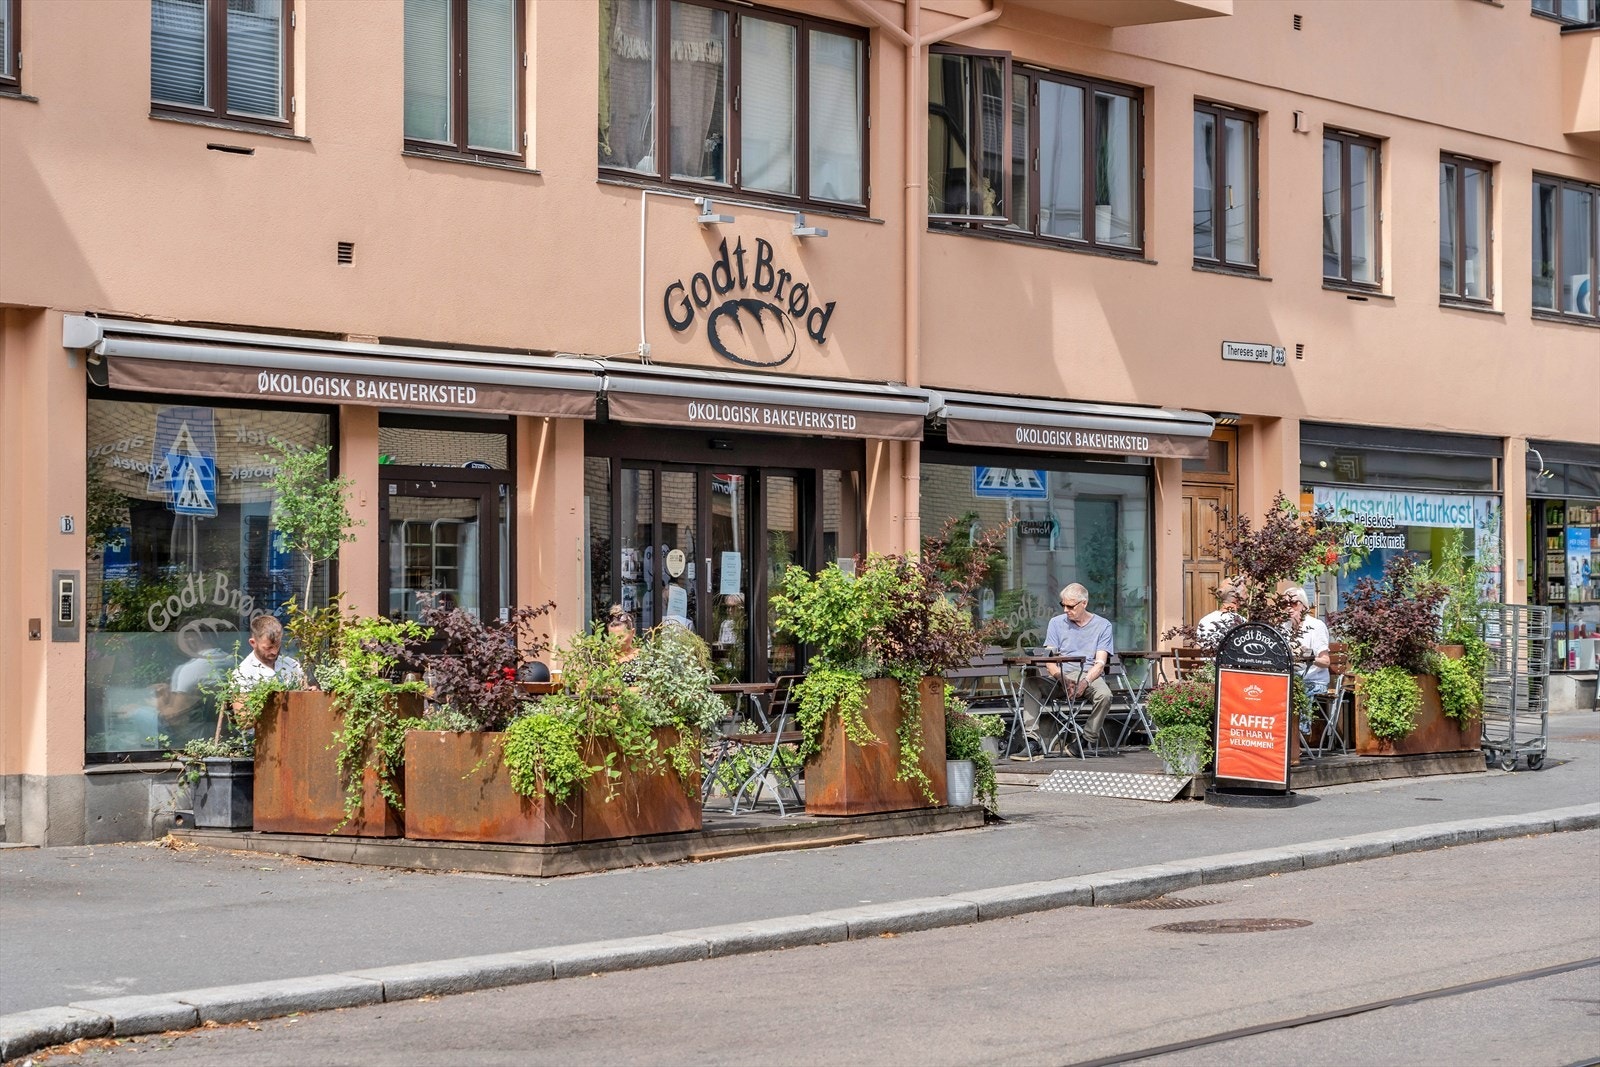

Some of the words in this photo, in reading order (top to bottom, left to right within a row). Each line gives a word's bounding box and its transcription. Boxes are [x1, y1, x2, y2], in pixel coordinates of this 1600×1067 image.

[664, 235, 748, 332] Godt
[752, 237, 837, 345] Brød
[1227, 344, 1254, 357] Thereses
[1255, 348, 1268, 360] gate
[1275, 349, 1285, 362] 33
[257, 370, 351, 397] ØKOLOGISK
[356, 379, 477, 405] BAKEVERKSTED
[688, 401, 760, 423] ØKOLOGISK
[763, 408, 857, 430] BAKEVERKSTED
[1016, 426, 1073, 446] ØKOLOGISK
[1075, 432, 1149, 451] BAKEVERKSTED
[1335, 491, 1401, 521] Kinsarvik
[1404, 495, 1472, 524] Naturkost
[65, 518, 71, 532] B
[1354, 512, 1395, 528] Helsekost
[1388, 533, 1405, 548] mat
[148, 570, 208, 632] Godt
[1234, 630, 1254, 647] Godt
[1256, 630, 1278, 649] Brød
[1230, 713, 1275, 729] KAFFE?
[1229, 738, 1274, 749] VELKOMMEN!
[1230, 728, 1244, 737] DET
[1246, 730, 1263, 739] HAR
[1264, 732, 1275, 741] VI,
